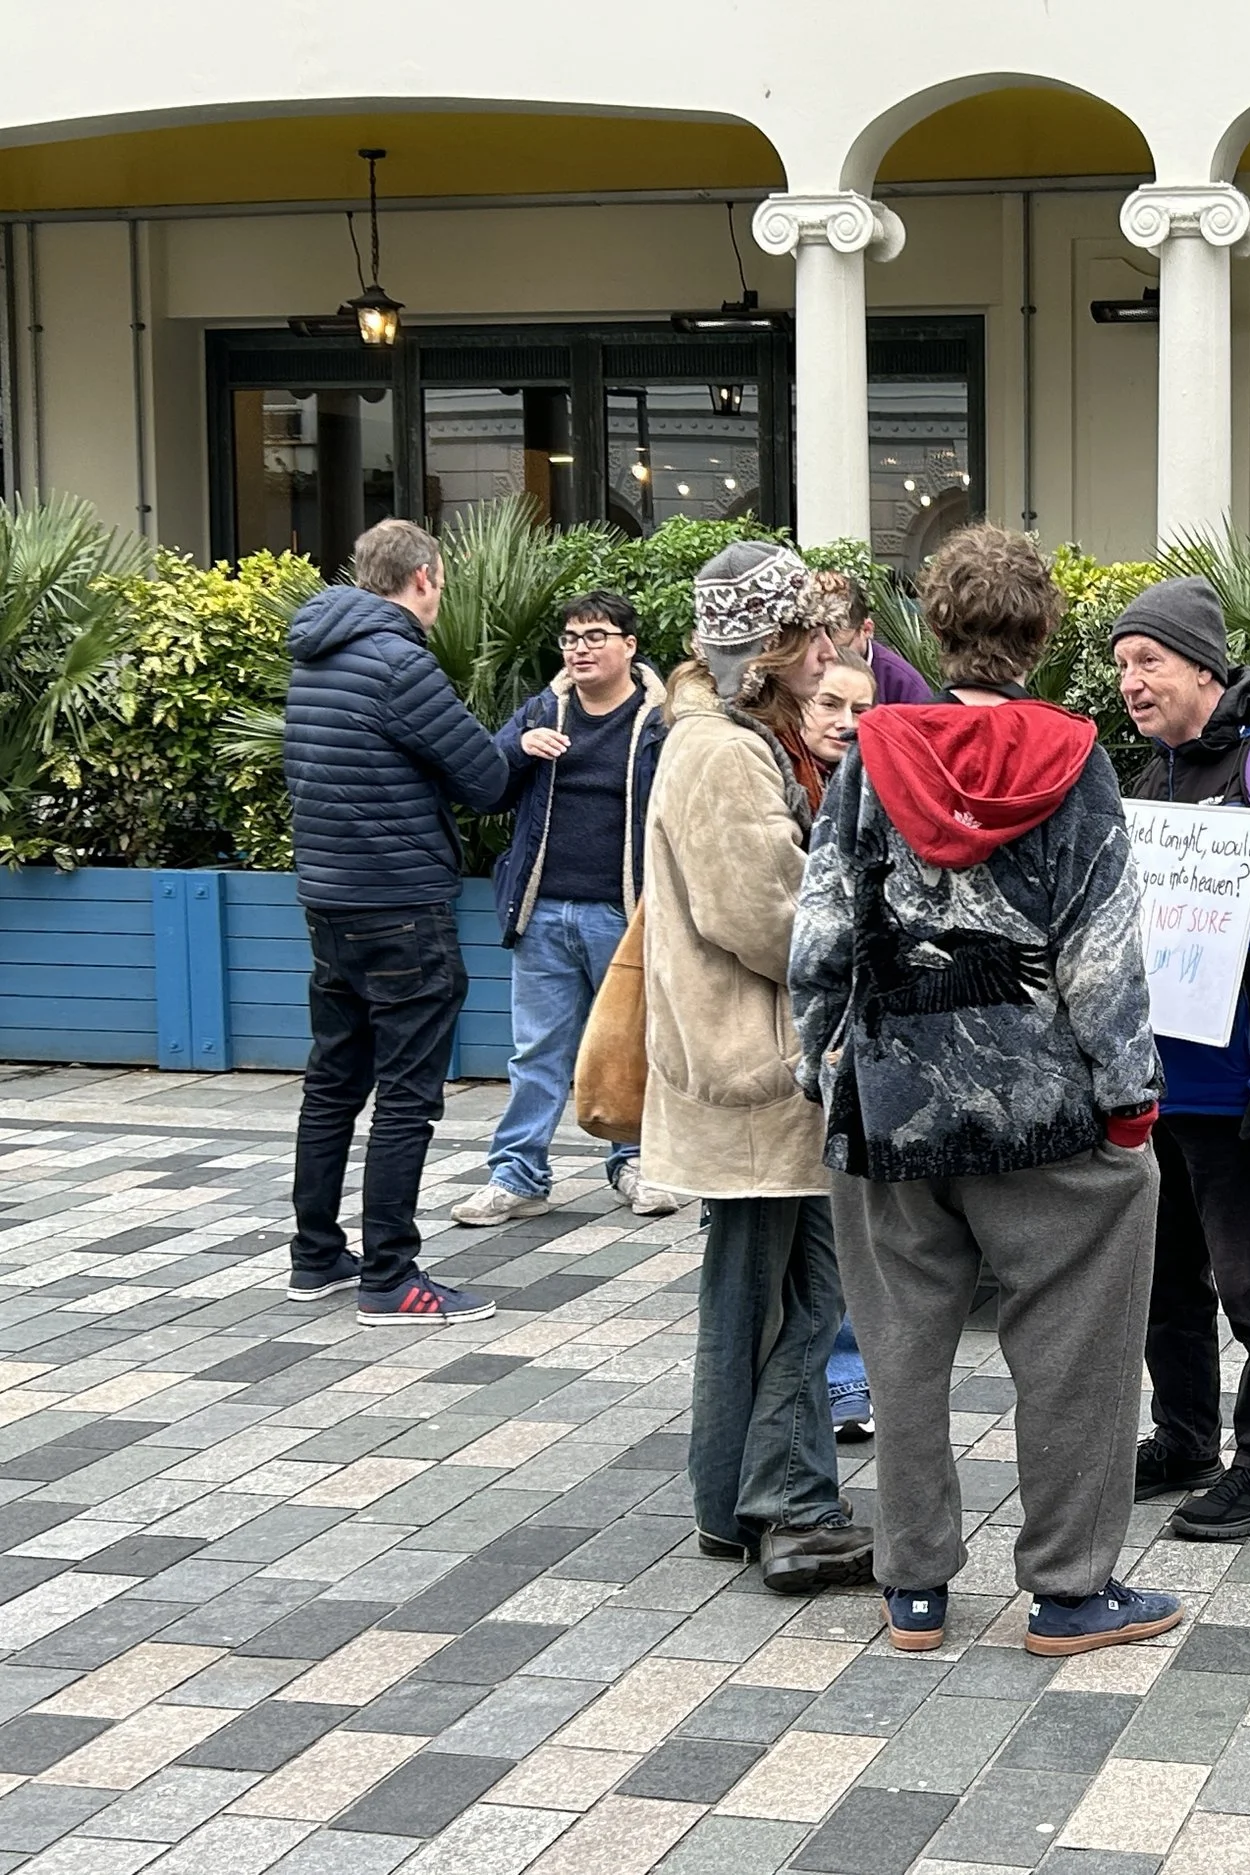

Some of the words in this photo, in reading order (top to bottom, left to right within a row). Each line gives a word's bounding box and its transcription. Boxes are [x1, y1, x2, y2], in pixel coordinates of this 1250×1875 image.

[1141, 870, 1165, 899] you
[1189, 863, 1250, 898] heaven?
[1156, 903, 1188, 931] NOT
[1187, 907, 1233, 934] SURE
